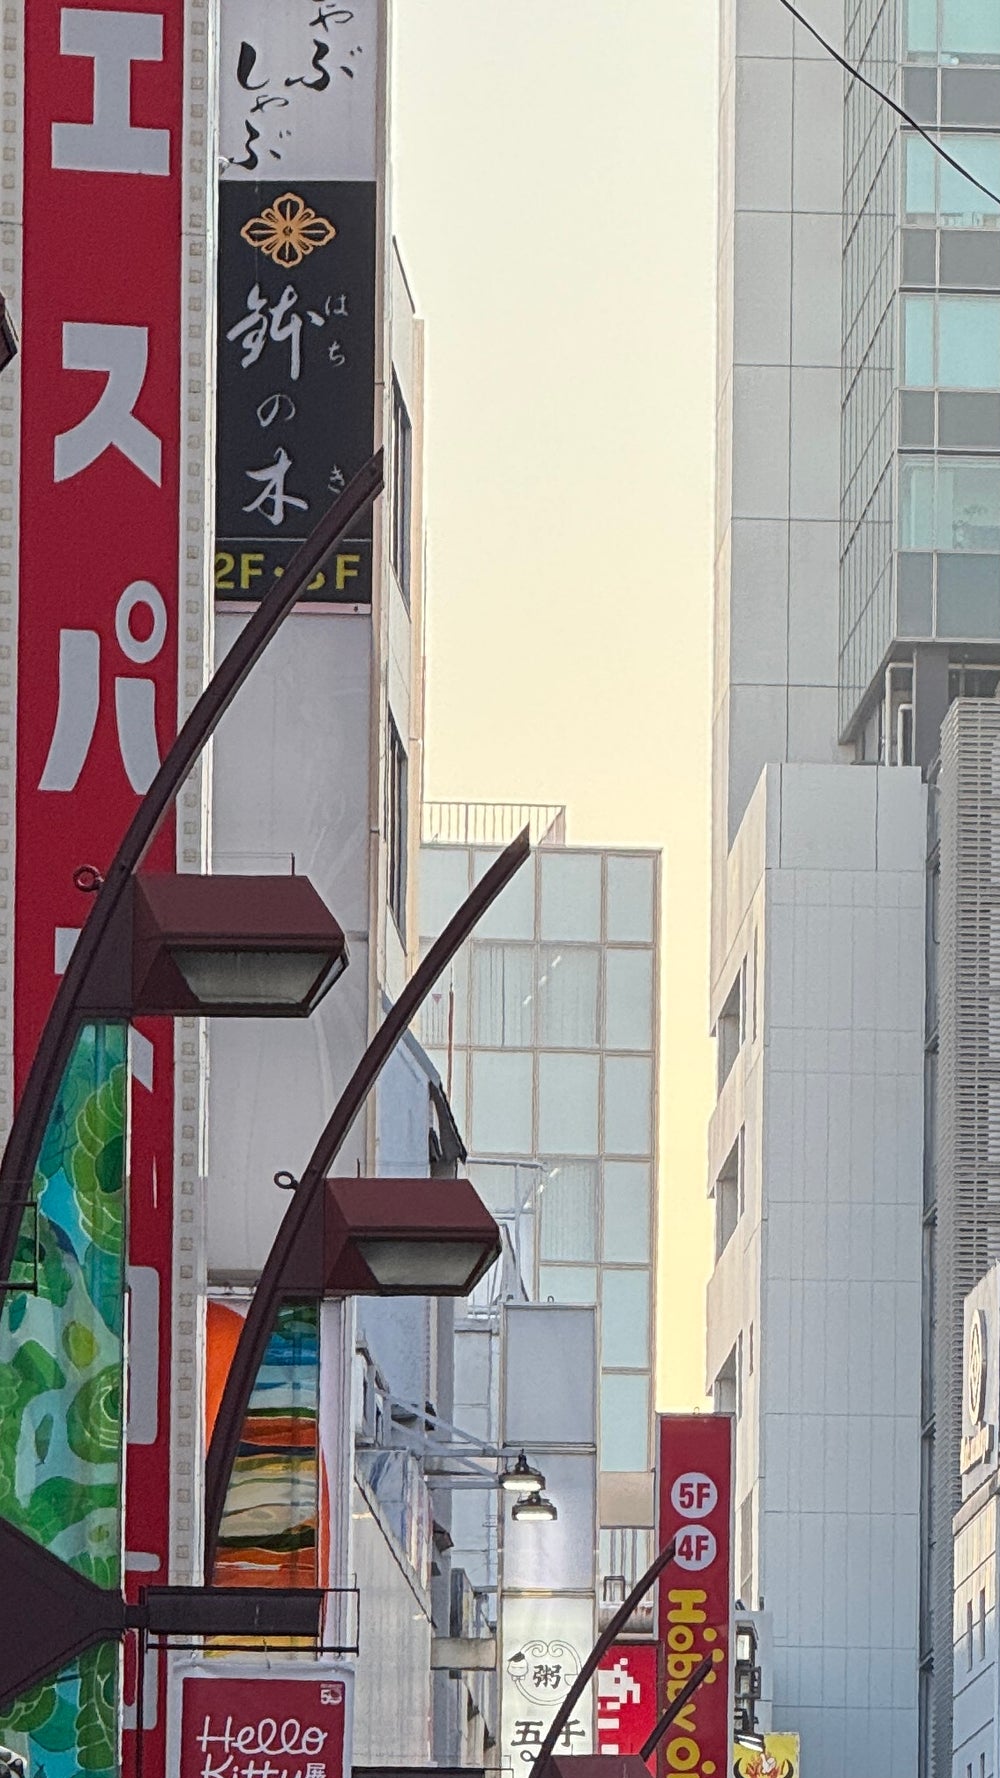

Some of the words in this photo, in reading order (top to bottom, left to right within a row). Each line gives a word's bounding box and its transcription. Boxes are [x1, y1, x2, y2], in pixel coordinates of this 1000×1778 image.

[227, 283, 324, 526] 鉢の木
[679, 1481, 711, 1510] 5F
[678, 1533, 710, 1561] 4F
[532, 1664, 562, 1690] 粥
[196, 1715, 328, 1756] Hello
